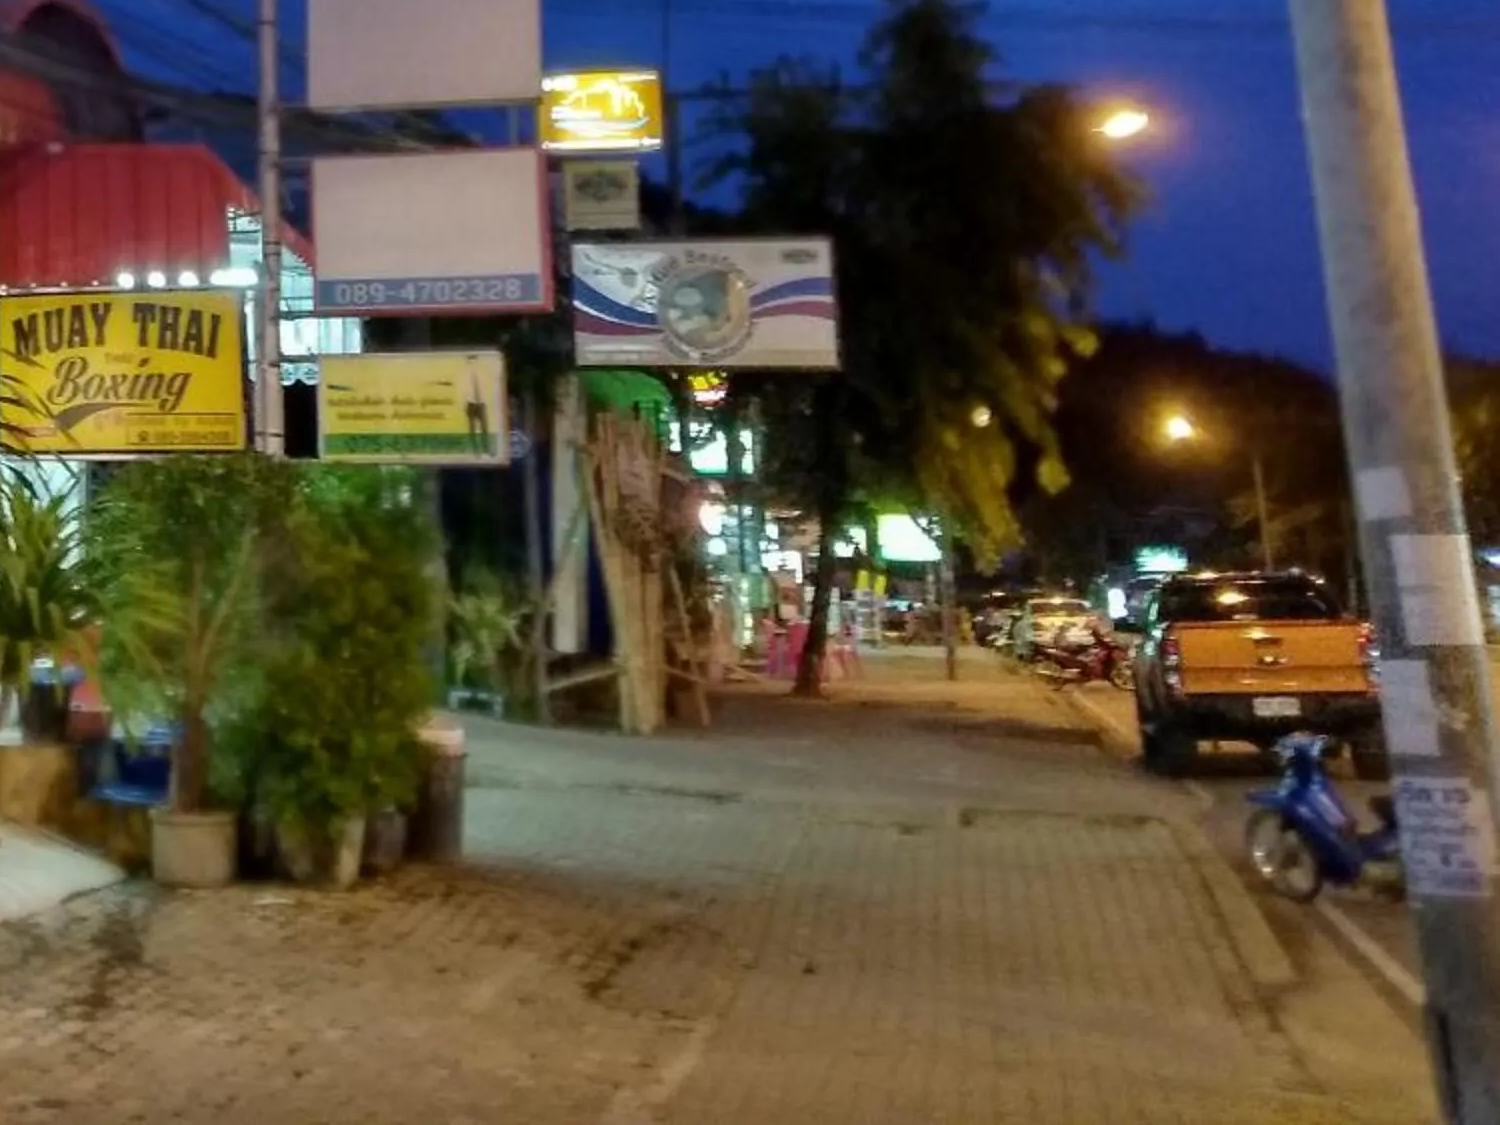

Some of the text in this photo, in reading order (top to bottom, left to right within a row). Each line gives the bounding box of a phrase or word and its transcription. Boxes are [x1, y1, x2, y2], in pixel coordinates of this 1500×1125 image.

[335, 278, 522, 305] 089-4702328
[12, 302, 221, 359] MUAY THAI
[46, 355, 193, 412] Boxing
